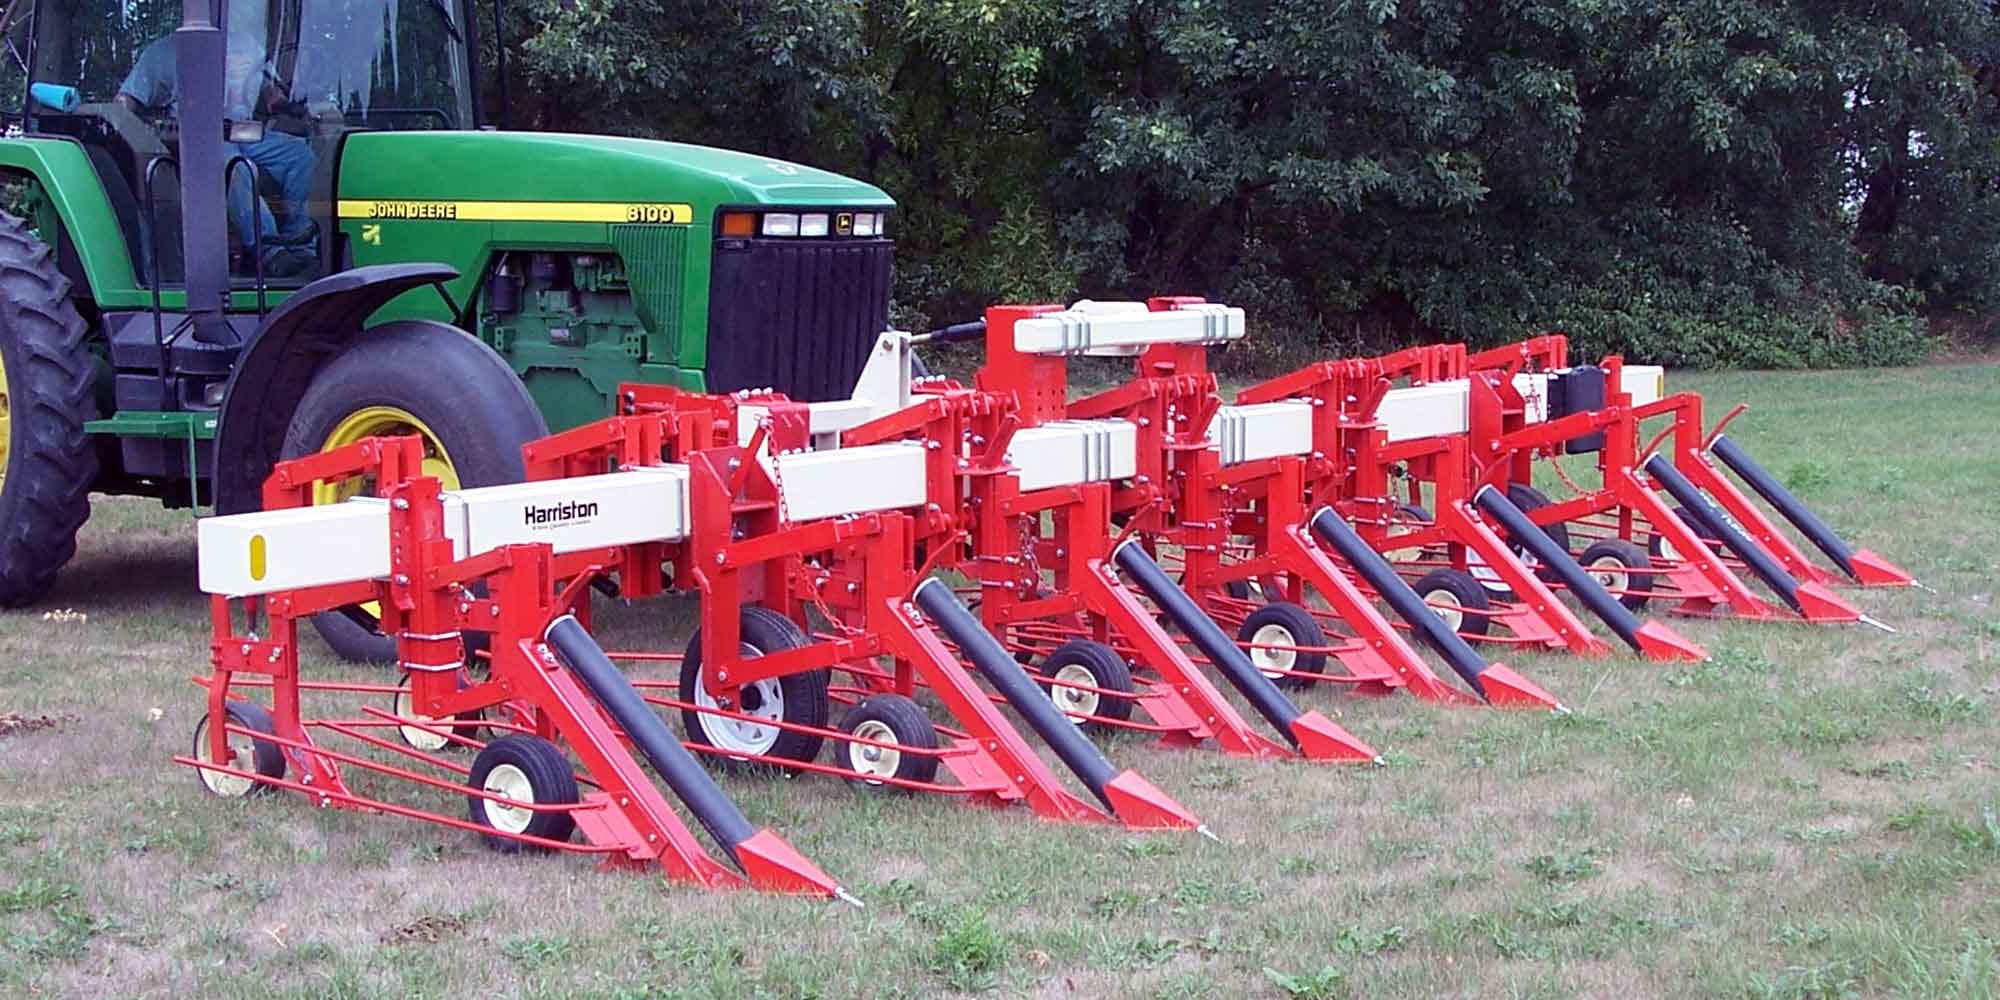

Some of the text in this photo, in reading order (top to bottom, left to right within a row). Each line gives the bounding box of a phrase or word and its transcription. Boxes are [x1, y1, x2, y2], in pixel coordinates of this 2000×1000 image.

[368, 202, 456, 220] JOHN DEERE
[627, 206, 674, 223] 8100
[524, 500, 598, 525] Harriston
